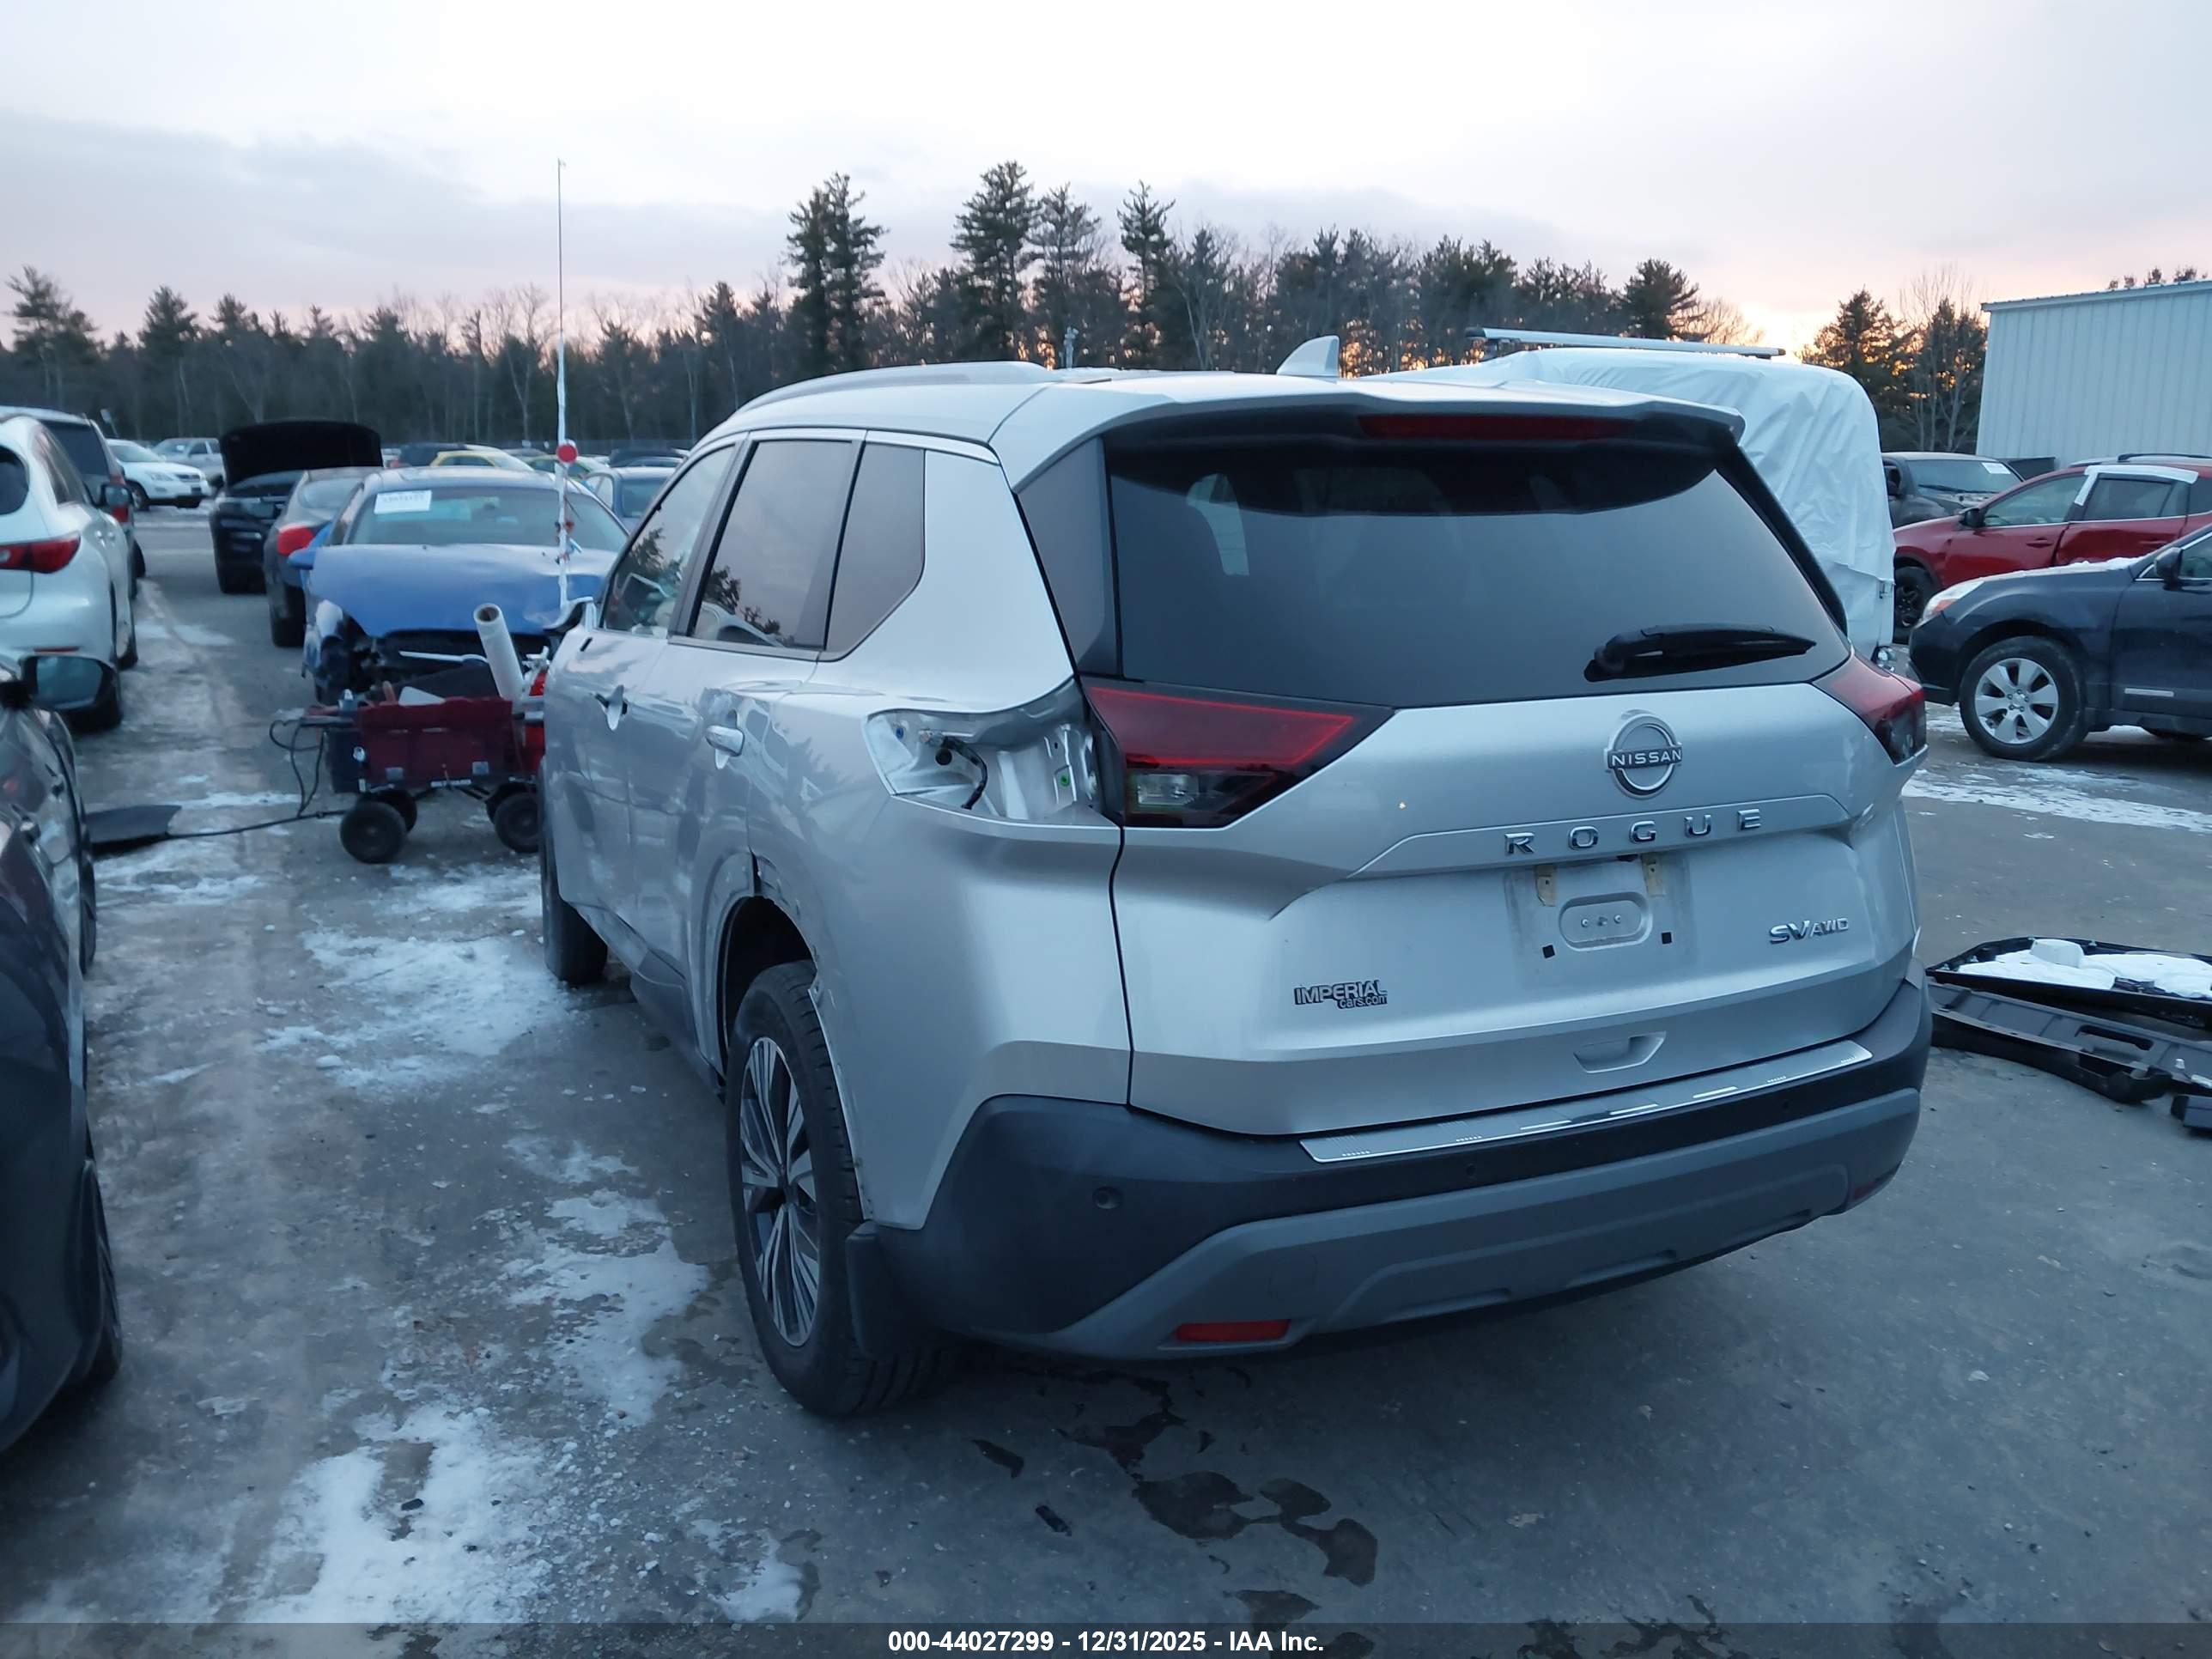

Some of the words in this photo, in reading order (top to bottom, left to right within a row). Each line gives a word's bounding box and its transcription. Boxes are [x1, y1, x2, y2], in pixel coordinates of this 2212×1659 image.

[1612, 750, 1681, 766] NISSAN
[1504, 809, 1761, 854] ROGUE
[1769, 920, 1810, 945] SV
[1809, 917, 1849, 937] AWD
[1294, 980, 1388, 1005] IMPERIAL
[1338, 995, 1388, 1009] cars.com
